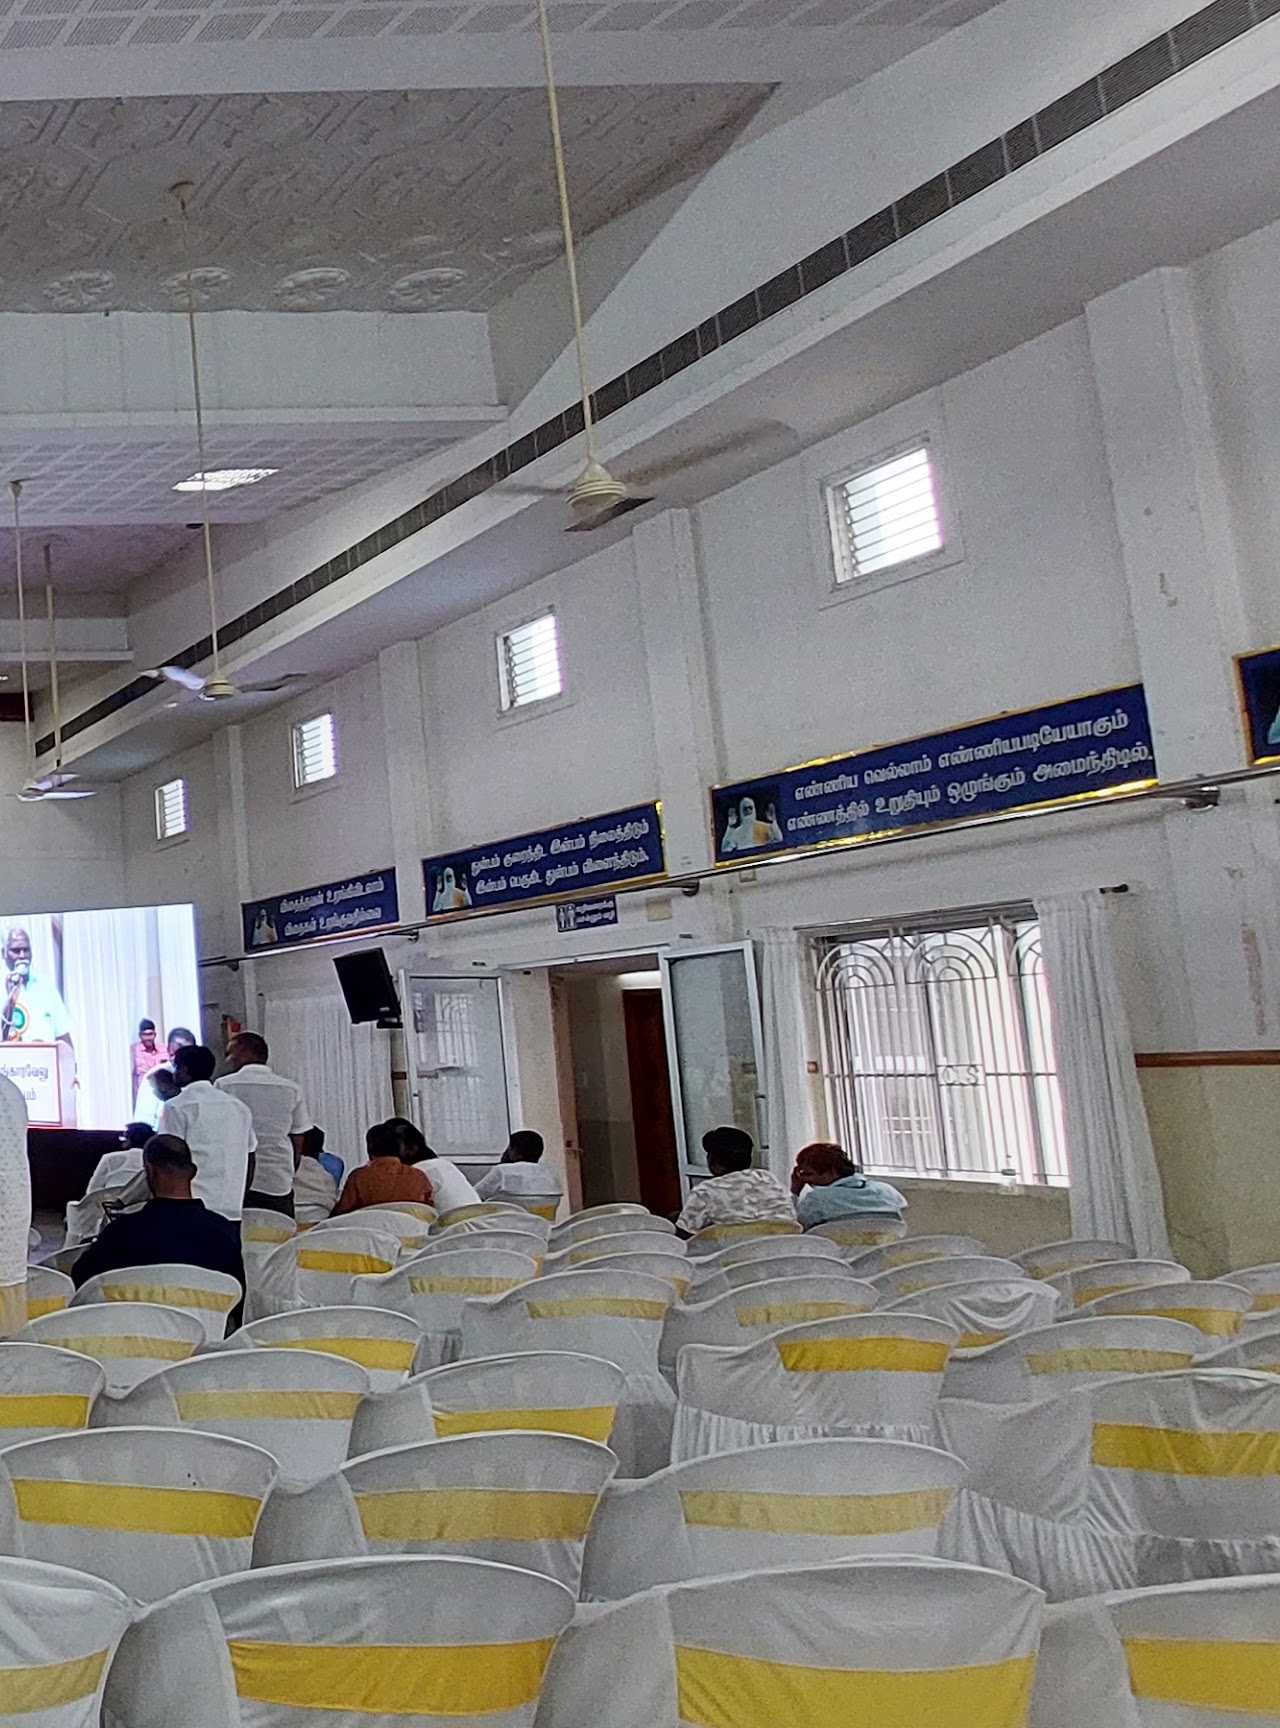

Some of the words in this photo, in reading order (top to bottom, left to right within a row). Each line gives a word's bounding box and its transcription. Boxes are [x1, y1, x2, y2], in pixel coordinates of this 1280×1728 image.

[787, 800, 870, 831] எண்ணத்தில்
[875, 783, 941, 816] உறுதியும்
[947, 766, 1026, 805] ஒழுங்கும்
[795, 774, 859, 801] எண்ணிய
[863, 754, 932, 785] வெல்லாம்
